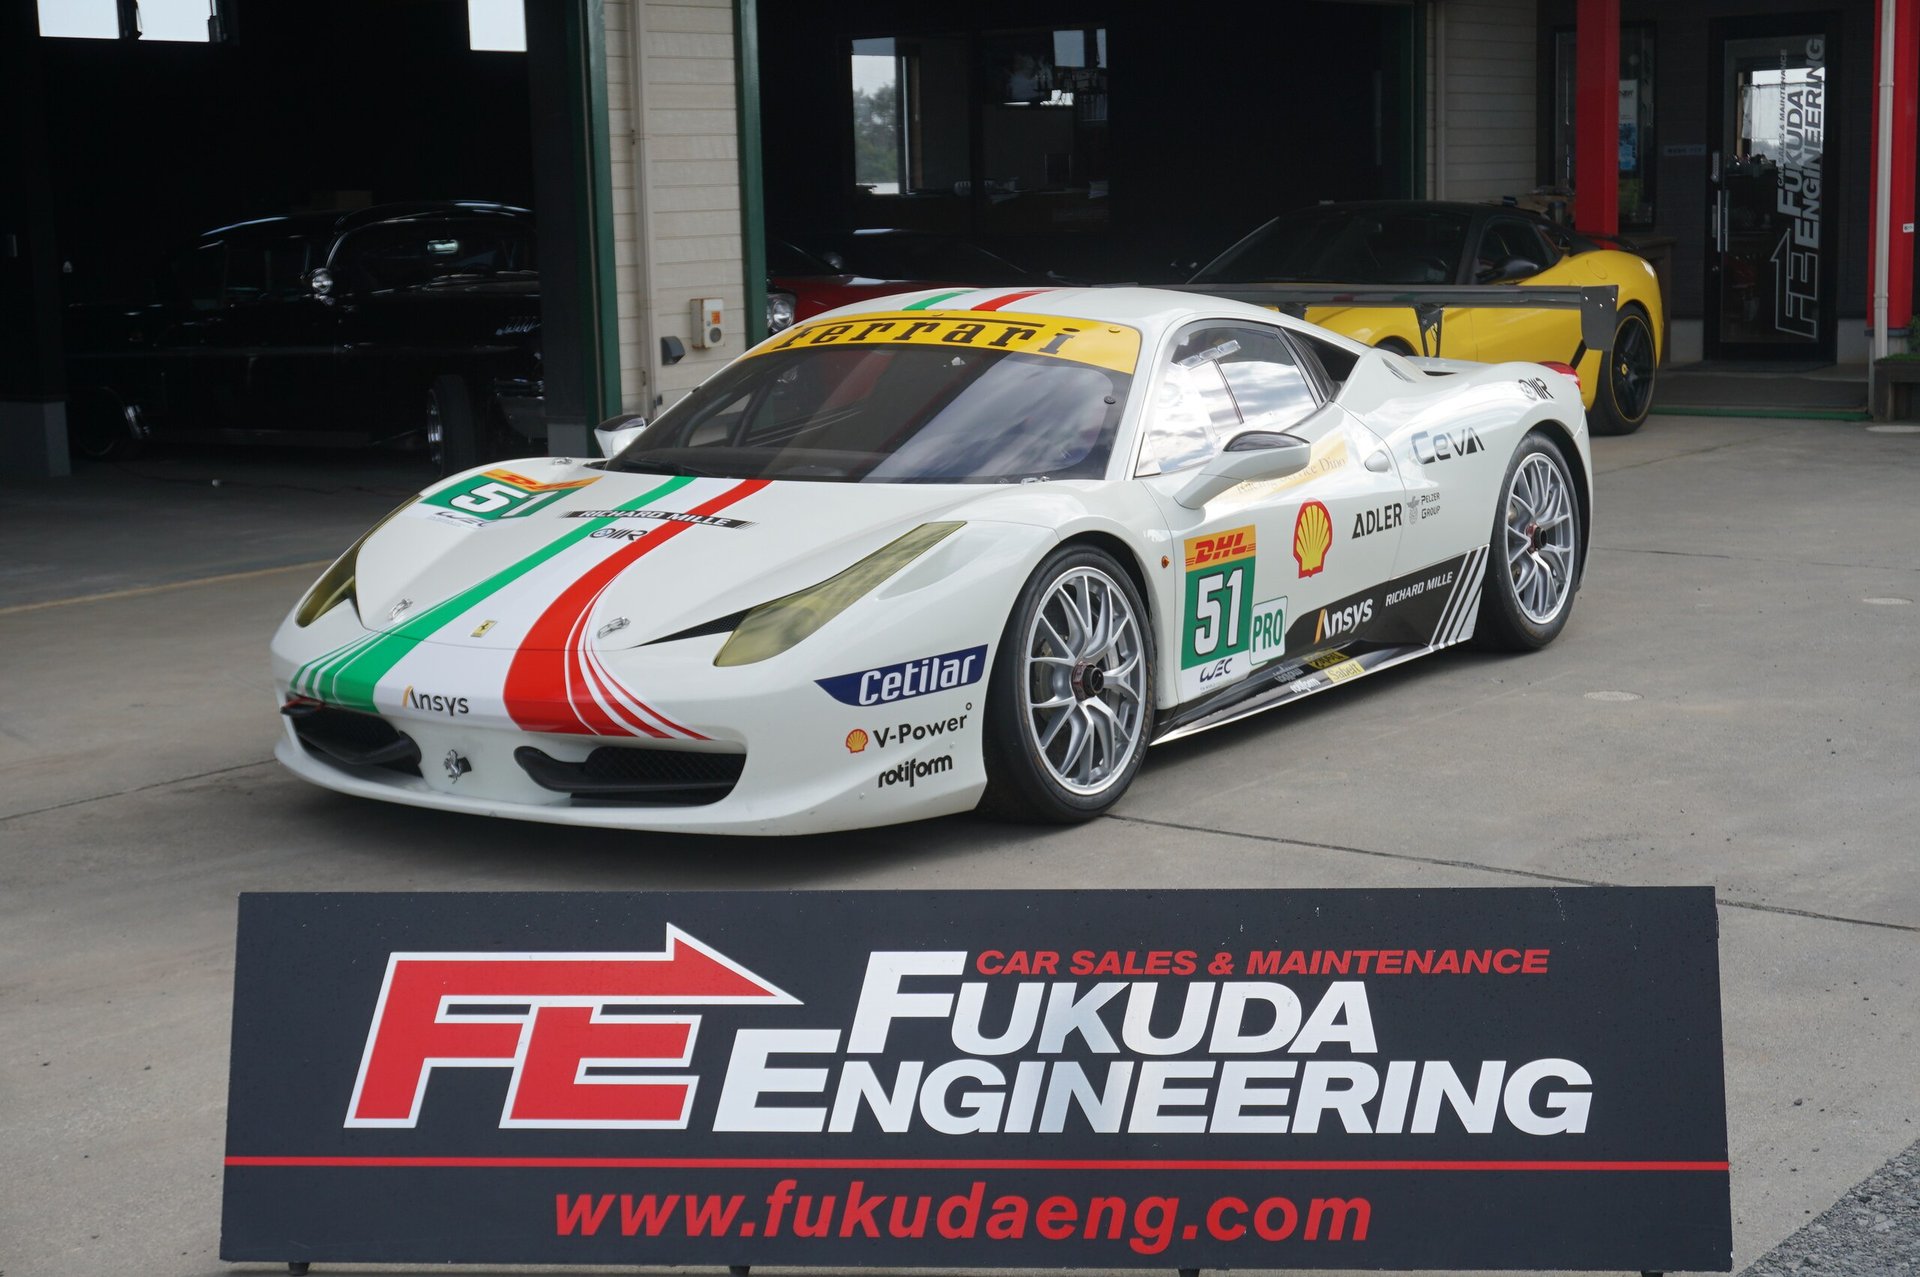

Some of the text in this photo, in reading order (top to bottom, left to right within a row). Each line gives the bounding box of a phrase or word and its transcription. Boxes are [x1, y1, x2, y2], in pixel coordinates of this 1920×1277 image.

[1777, 90, 1804, 216] FUKUDA
[1795, 37, 1825, 249] ENGINEERING
[579, 509, 732, 527] RICHARD MILLE
[1351, 502, 1403, 539] ADLER
[1421, 505, 1441, 519] GROUP
[1195, 532, 1248, 564] DHL
[1385, 571, 1453, 607] RICHARD MILLE
[1194, 567, 1244, 656] 51
[1252, 608, 1284, 653] PRO
[1313, 598, 1373, 645] Ansys
[859, 655, 976, 706] Cetilar
[1200, 657, 1233, 683] WEC
[403, 685, 469, 717] Ansys
[878, 754, 953, 788] rotiform
[976, 948, 1550, 976] CAR SALES & MAINTENANCE
[846, 951, 1380, 1056] FUKUDA
[712, 1028, 1593, 1136] ENGINEERING
[555, 1180, 1372, 1256] www.fukudaeng.com
